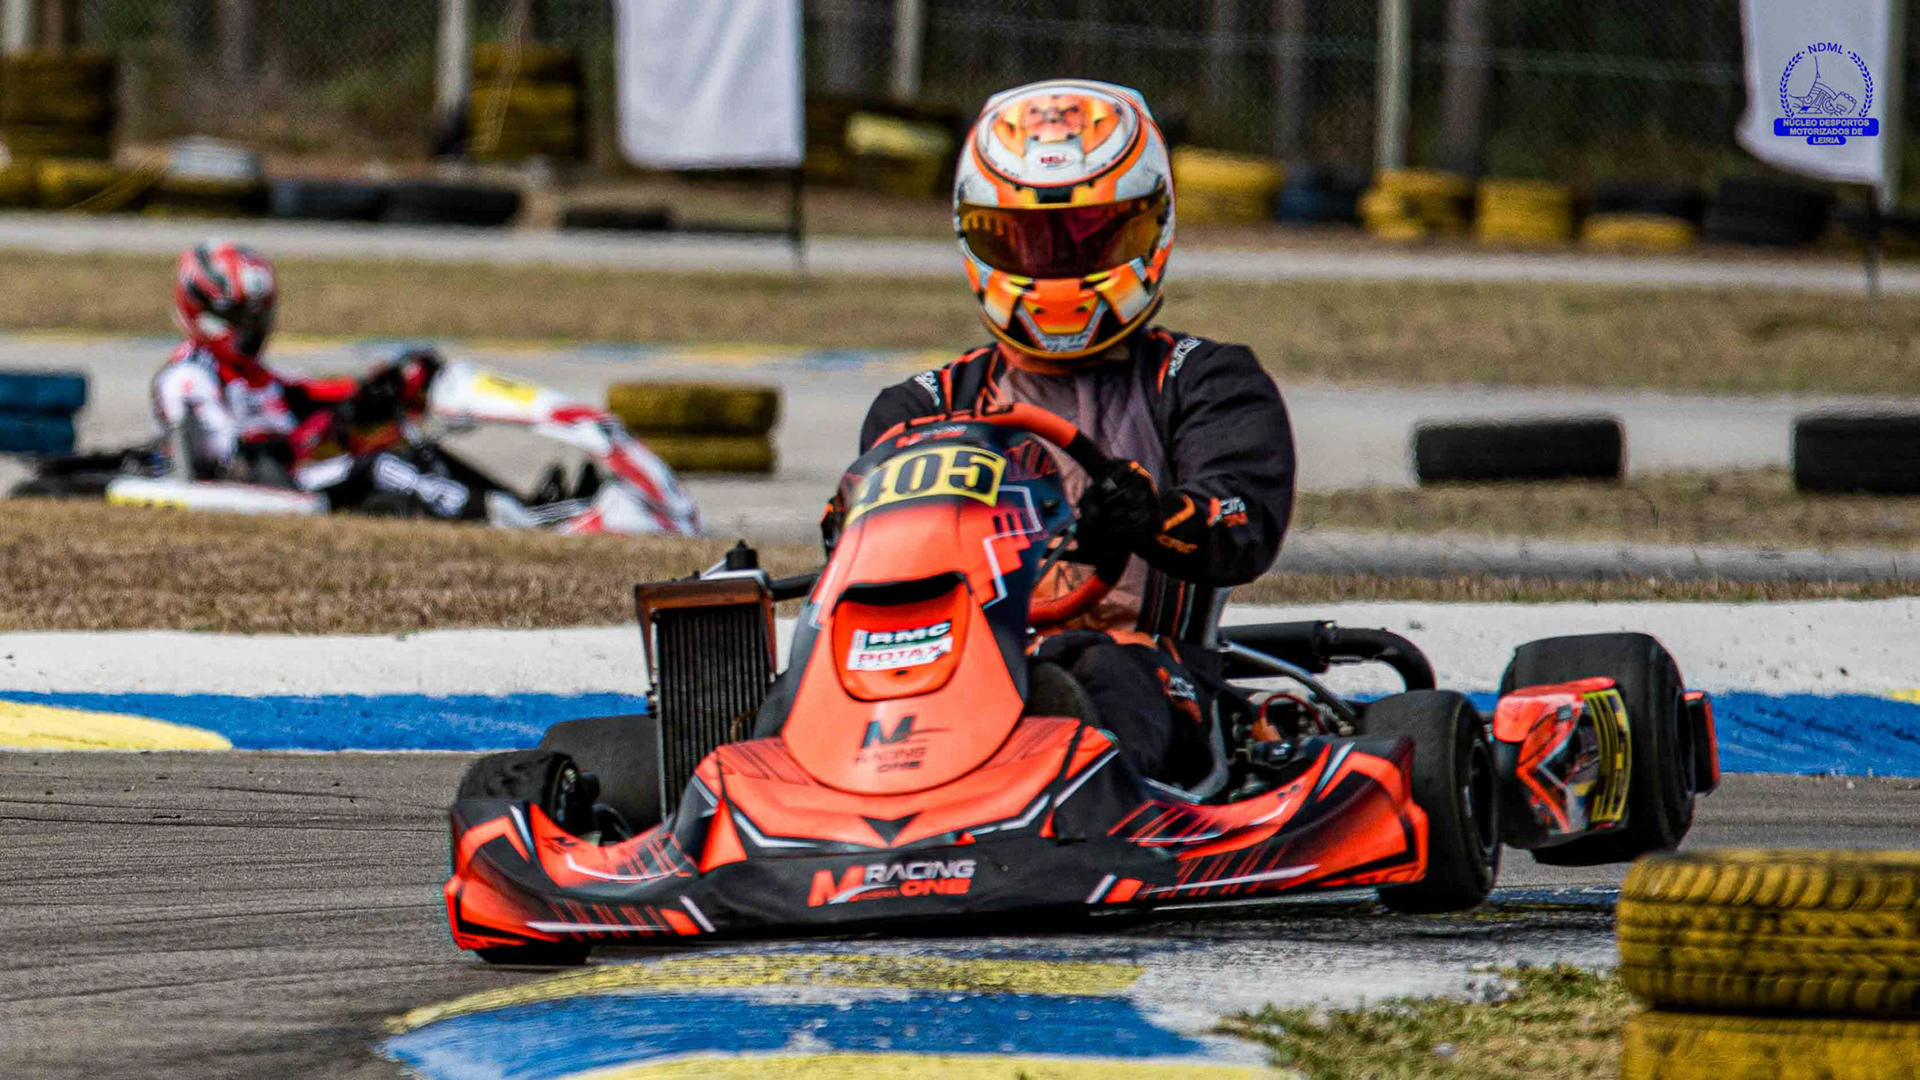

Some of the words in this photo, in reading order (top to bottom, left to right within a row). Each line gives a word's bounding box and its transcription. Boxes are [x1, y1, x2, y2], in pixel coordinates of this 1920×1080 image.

[868, 621, 952, 645] RMC
[807, 865, 866, 907] M
[865, 859, 977, 884] RACING
[900, 878, 971, 897] ONE
